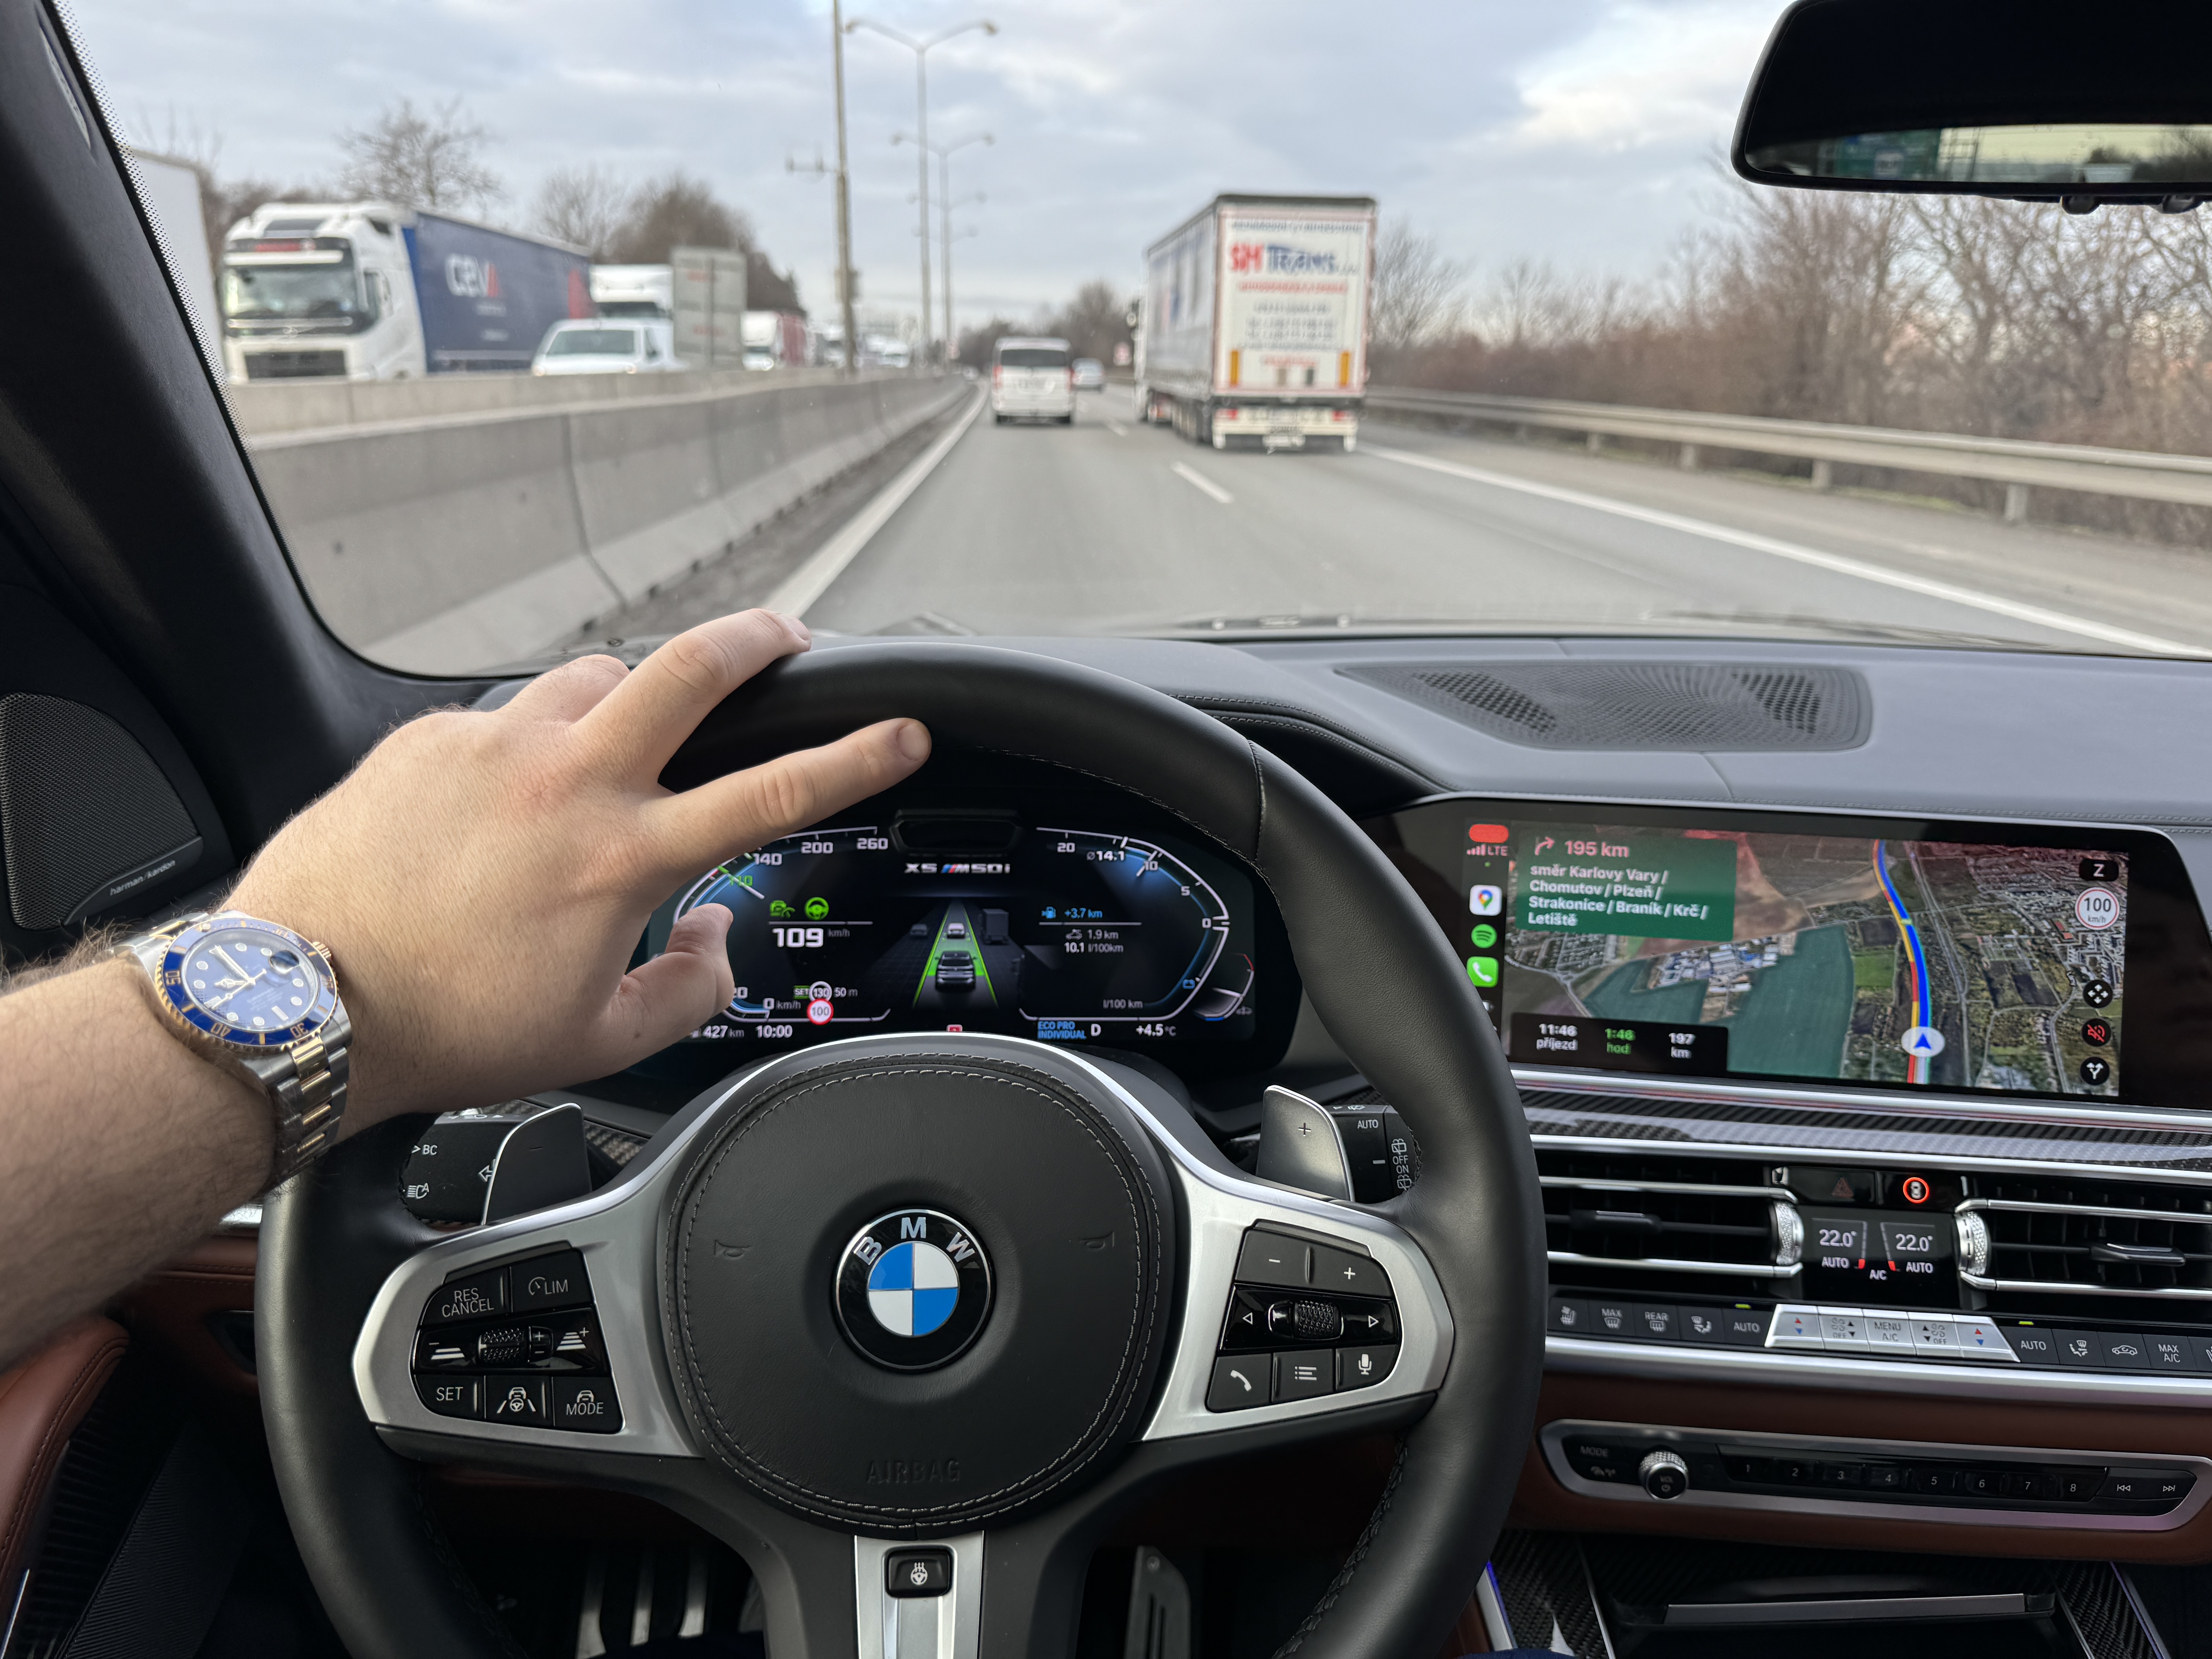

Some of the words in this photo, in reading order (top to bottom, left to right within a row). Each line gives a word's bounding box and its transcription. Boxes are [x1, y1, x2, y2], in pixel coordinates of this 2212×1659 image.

[801, 842, 833, 854] 200
[857, 838, 888, 850] 260
[1057, 842, 1075, 852] 20
[1565, 840, 1597, 855] 195
[1601, 842, 1629, 857] km
[1487, 846, 1508, 856] LTE
[752, 853, 782, 866] 140
[1144, 861, 1159, 871] 10
[1530, 863, 1566, 877] směr
[1569, 866, 1624, 881] Karlovy
[1626, 868, 1661, 883] Vary
[1661, 870, 1669, 884] /
[1180, 886, 1190, 896] 5
[1529, 879, 1603, 895] Chomutov
[1604, 883, 1612, 898] /
[1613, 883, 1654, 899] Plzeň
[1654, 886, 1663, 901] /
[1528, 896, 1606, 912] Strakonice
[1606, 900, 1615, 914] /
[1616, 900, 1663, 915] Braník
[1664, 902, 1673, 918] /
[1673, 903, 1700, 917] Krč
[1700, 905, 1709, 920] /
[2083, 897, 2112, 912] 100
[1088, 908, 1103, 918] km
[1202, 918, 1212, 929] 0
[1528, 912, 1578, 927] Letiště
[2087, 915, 2107, 924] km/h
[772, 928, 824, 948] 109
[828, 929, 850, 937] km/h
[1087, 930, 1103, 940] 1.9
[1104, 930, 1118, 940] km
[1064, 943, 1084, 953] 10.1
[794, 988, 809, 996] SET
[814, 988, 828, 998] 130
[833, 987, 847, 998] 50
[763, 998, 775, 1010] 0
[776, 1000, 801, 1010] km/h
[1128, 999, 1143, 1009] km
[812, 1006, 830, 1017] 100
[756, 1025, 793, 1038] 10:00
[1037, 1022, 1056, 1030] ECO
[1056, 1022, 1076, 1030] PRO
[1091, 1024, 1101, 1036] D
[1539, 1023, 1578, 1037] 11:46
[702, 1025, 728, 1039] 427
[729, 1029, 745, 1038] km
[1037, 1030, 1087, 1040] INDIVIDUAL
[1605, 1028, 1636, 1042] 1:46
[1536, 1037, 1578, 1051] příjezd
[1668, 1032, 1696, 1046] 197
[1606, 1042, 1632, 1055] hod
[1671, 1046, 1692, 1060] km
[1357, 1119, 1379, 1129] AUTO
[1393, 1155, 1408, 1165] OFF
[1396, 1165, 1409, 1174] ON
[1821, 1256, 1850, 1269] AUTO
[1906, 1261, 1934, 1274] AUTO
[1869, 1269, 1887, 1281] A/C
[544, 1279, 569, 1295] LIM
[453, 1287, 479, 1303] RES
[441, 1298, 495, 1317] CANCEL
[1601, 1308, 1623, 1318] MAX
[1644, 1311, 1669, 1322] REAR
[1733, 1322, 1761, 1333] AUTO
[1874, 1321, 1902, 1331] MENU
[1882, 1333, 1899, 1342] A/C
[2021, 1340, 2047, 1351] AUTO
[2158, 1343, 2179, 1353] MAX
[2164, 1353, 2181, 1363] A/C
[436, 1386, 464, 1401] SET
[566, 1401, 604, 1415] MODE
[1580, 1445, 1609, 1458] MODE
[1746, 1464, 1751, 1473] 1
[1791, 1467, 1799, 1477] 2
[1837, 1471, 1845, 1480] 3
[1885, 1474, 1892, 1482] 4
[1931, 1476, 1937, 1485] 5
[1979, 1479, 1985, 1488] 6
[2025, 1482, 2031, 1491] 7
[2069, 1484, 2077, 1492] 8
